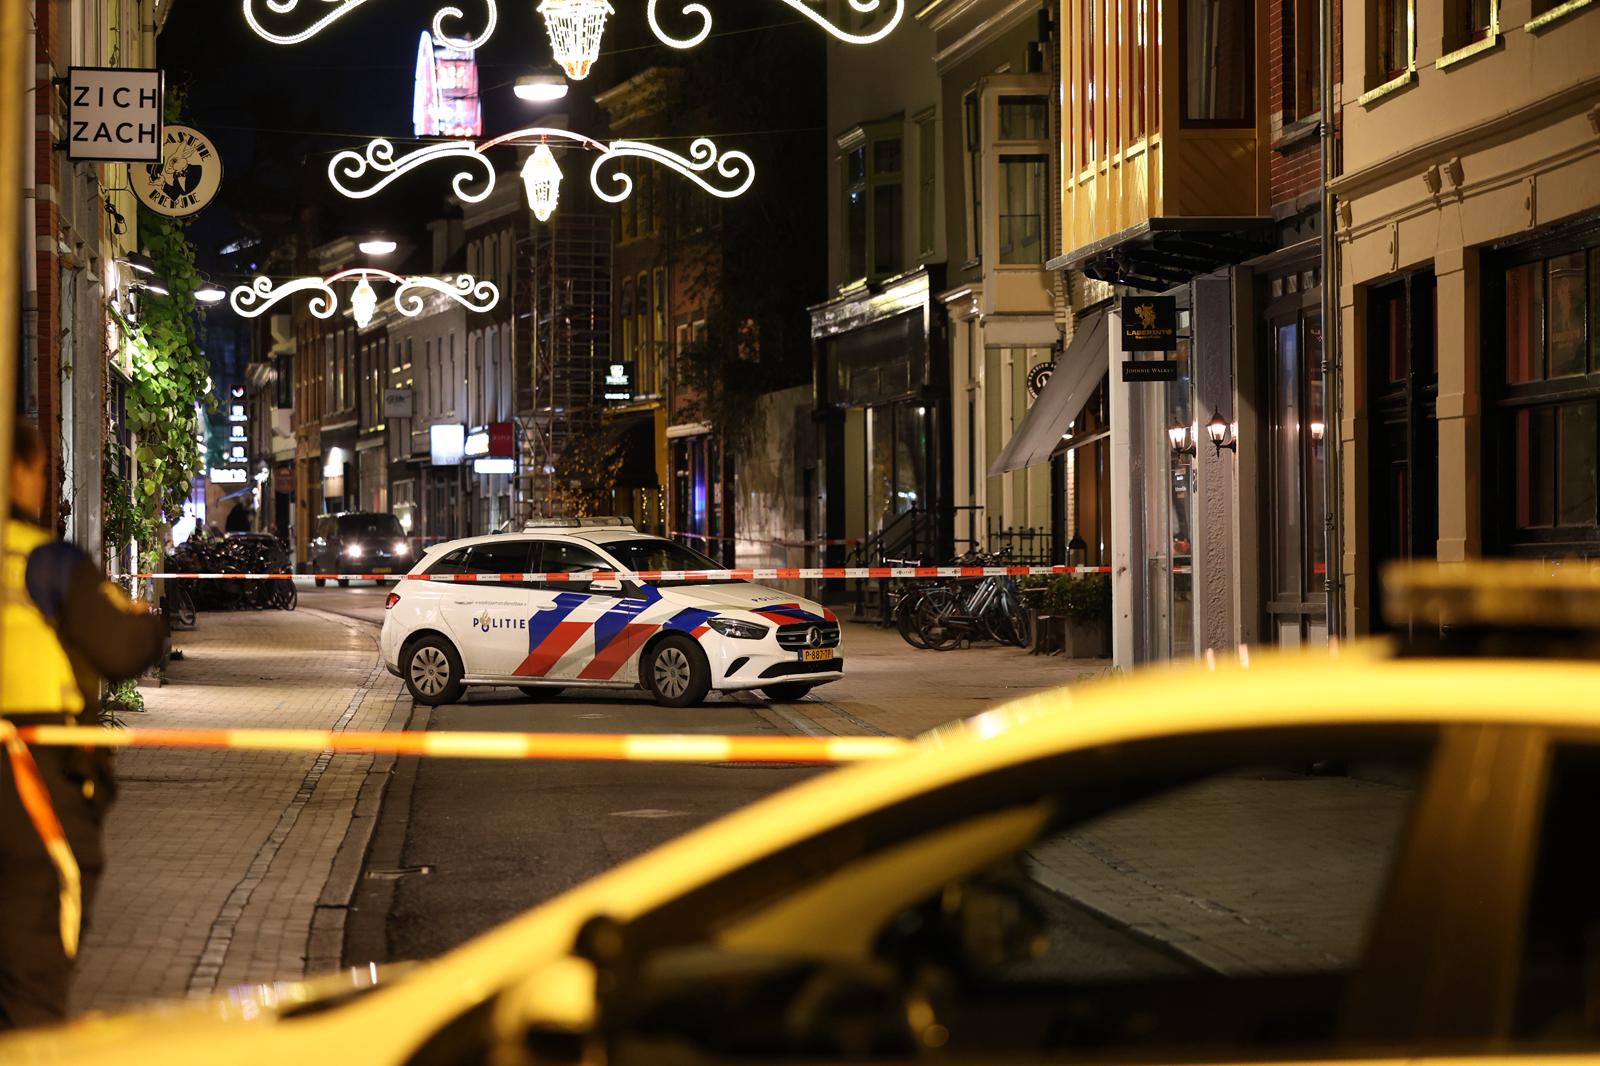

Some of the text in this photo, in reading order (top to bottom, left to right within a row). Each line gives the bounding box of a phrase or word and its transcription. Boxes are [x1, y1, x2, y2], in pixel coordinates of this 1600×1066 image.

[73, 86, 157, 109] ZICH
[72, 121, 156, 144] ZACH
[164, 131, 211, 162] ASTJE
[473, 616, 526, 632] POLITIE
